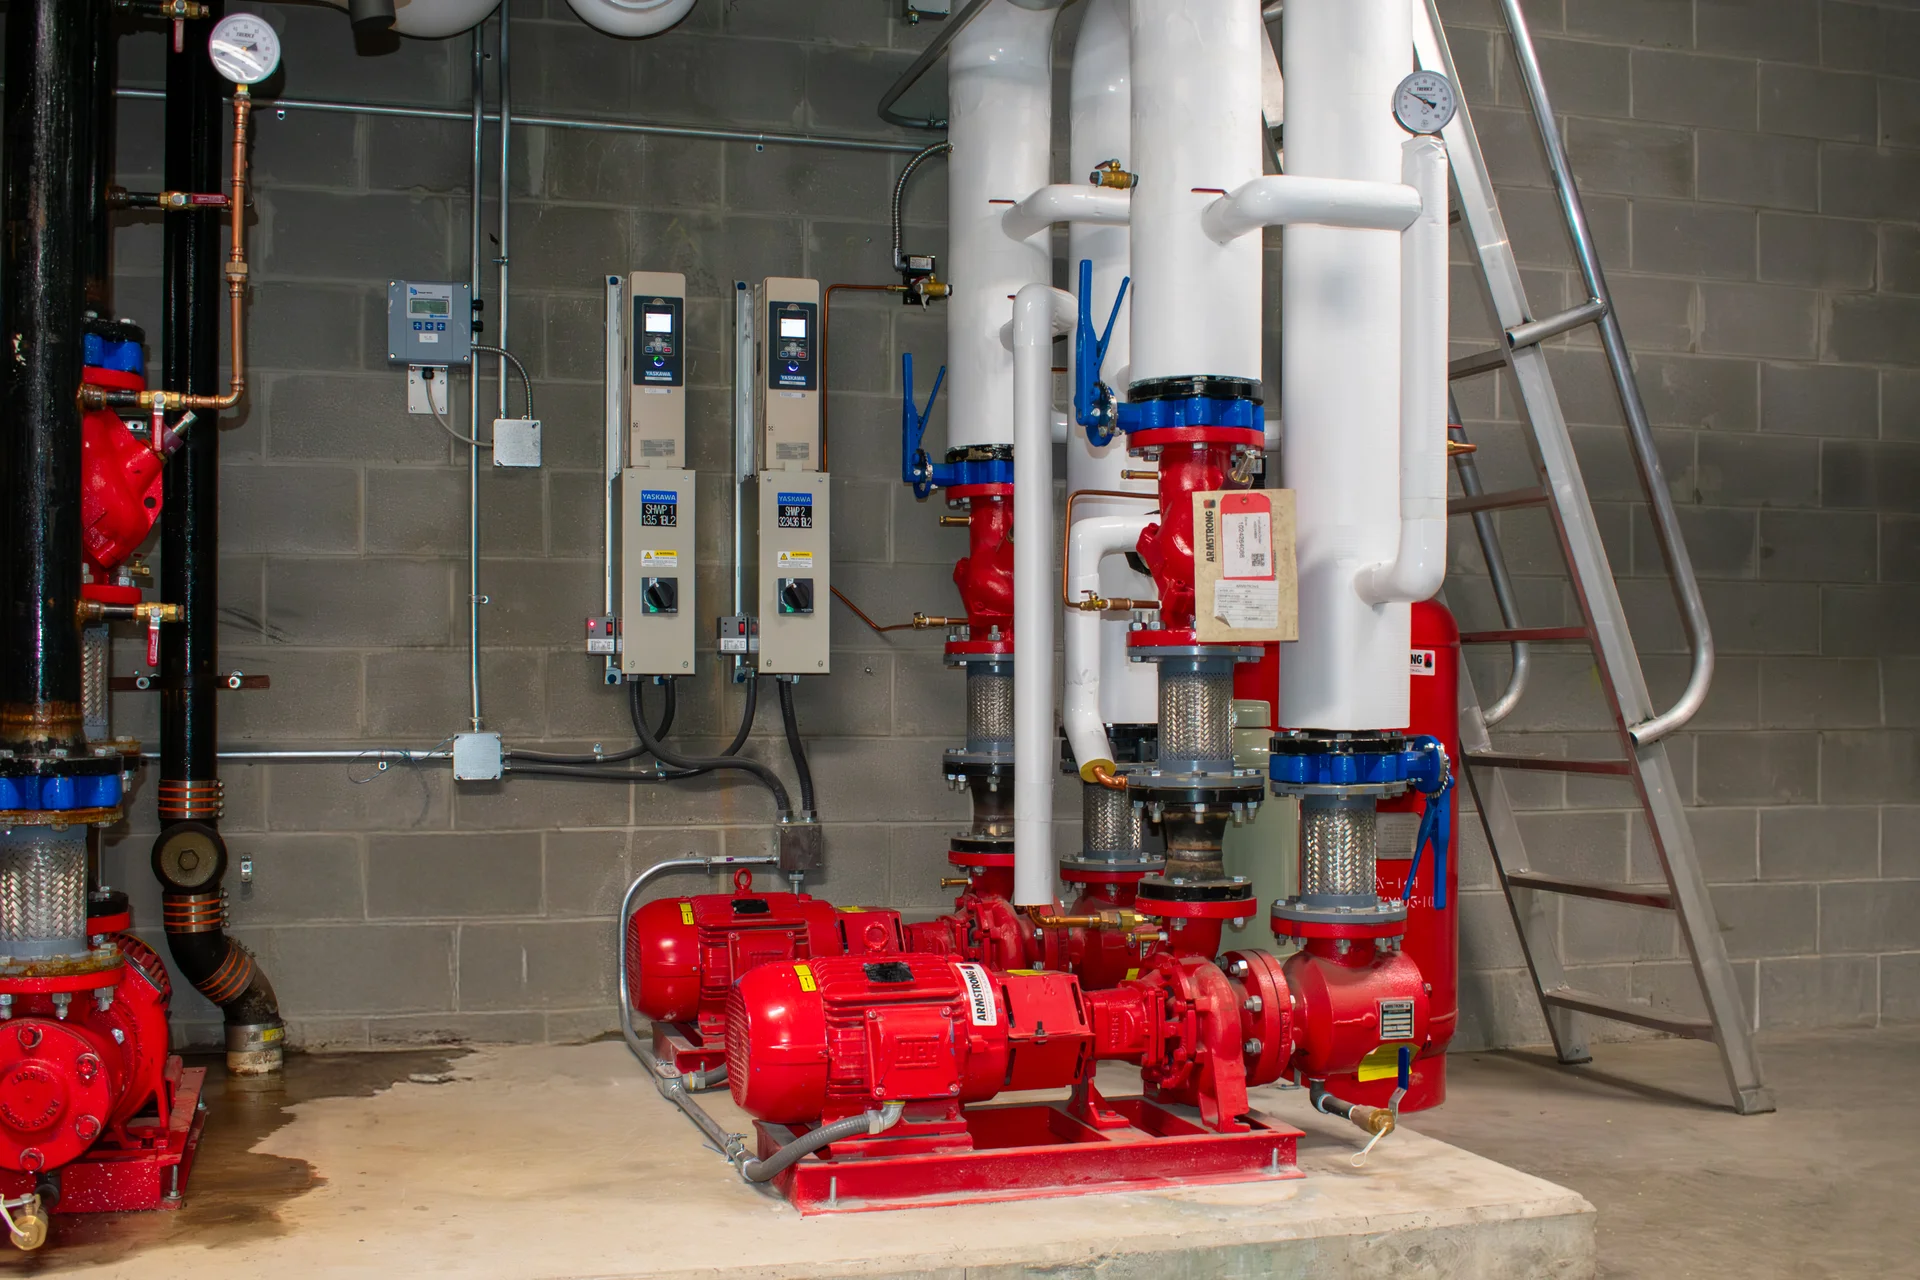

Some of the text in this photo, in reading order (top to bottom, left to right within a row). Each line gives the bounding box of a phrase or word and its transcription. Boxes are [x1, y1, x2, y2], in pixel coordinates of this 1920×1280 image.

[642, 493, 676, 501] YASKAWA
[669, 505, 674, 515] 1
[800, 507, 806, 517] 2
[1205, 510, 1215, 563] ARMSTRONG
[966, 970, 987, 1021] ARMSTRONG
